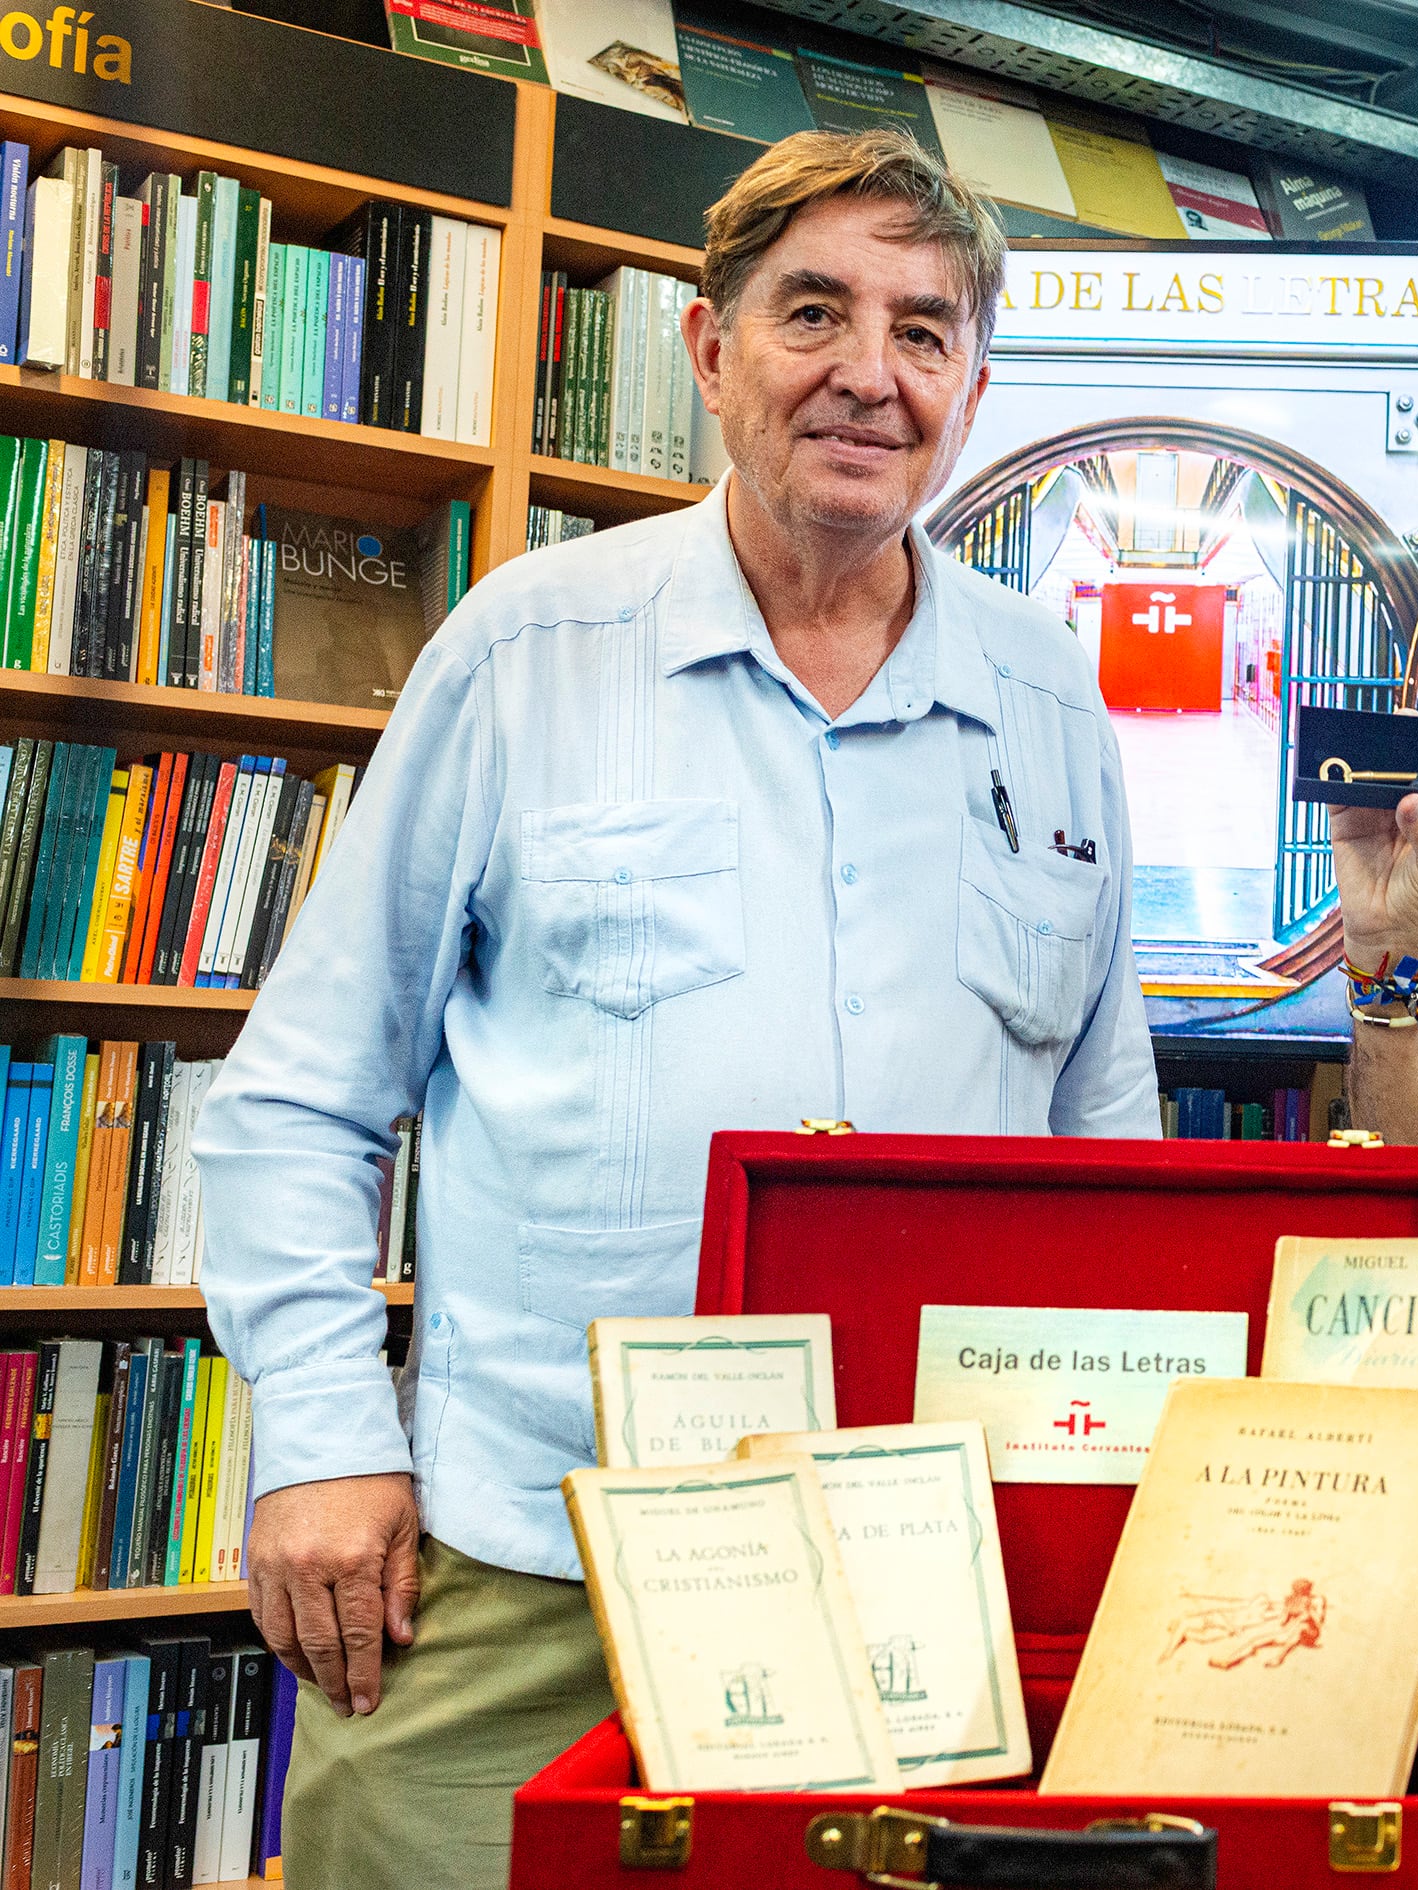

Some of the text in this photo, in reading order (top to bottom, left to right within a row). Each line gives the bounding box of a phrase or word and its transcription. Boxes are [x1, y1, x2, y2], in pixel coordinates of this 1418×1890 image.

[0, 5, 132, 85] ofía
[8, 158, 21, 220] Visión nocturna
[1280, 176, 1315, 196] Alma
[1293, 186, 1343, 211] máquina
[1030, 271, 1103, 312] DE
[1121, 271, 1225, 314] LAS
[282, 522, 382, 557] MARIO
[176, 492, 191, 624] BOEHM Universalismo radical
[190, 494, 207, 626] BOEHM Universalismo radical
[282, 543, 406, 588] BUNGE
[113, 835, 139, 895] SARTRE
[10, 1117, 21, 1169] KIERKEGAARD
[31, 1117, 42, 1169] KIERKEGAARD
[47, 1049, 78, 1250] CASTORIADIS FRANÇOIS DOSSE
[1343, 1255, 1408, 1270] MIGUEL
[959, 1347, 1206, 1375] Caja de las Letras
[674, 1411, 770, 1429] ÁGUILA
[650, 1438, 681, 1452] DE
[1005, 1442, 1151, 1454] Instituto Cervantes
[1238, 1427, 1374, 1444] RAFAEL ALBERTI
[108, 1443, 120, 1490] Rolando García
[1196, 1464, 1388, 1495] A LA PINTURA
[33, 1485, 42, 1506] devenir
[136, 1508, 145, 1532] MANUAL
[864, 1524, 890, 1539] DE
[900, 1520, 958, 1536] PLATA
[133, 1533, 143, 1560] PEQUEÑO
[656, 1542, 768, 1562] LA AGONÍA
[643, 1569, 798, 1592] CRISTIANISMO
